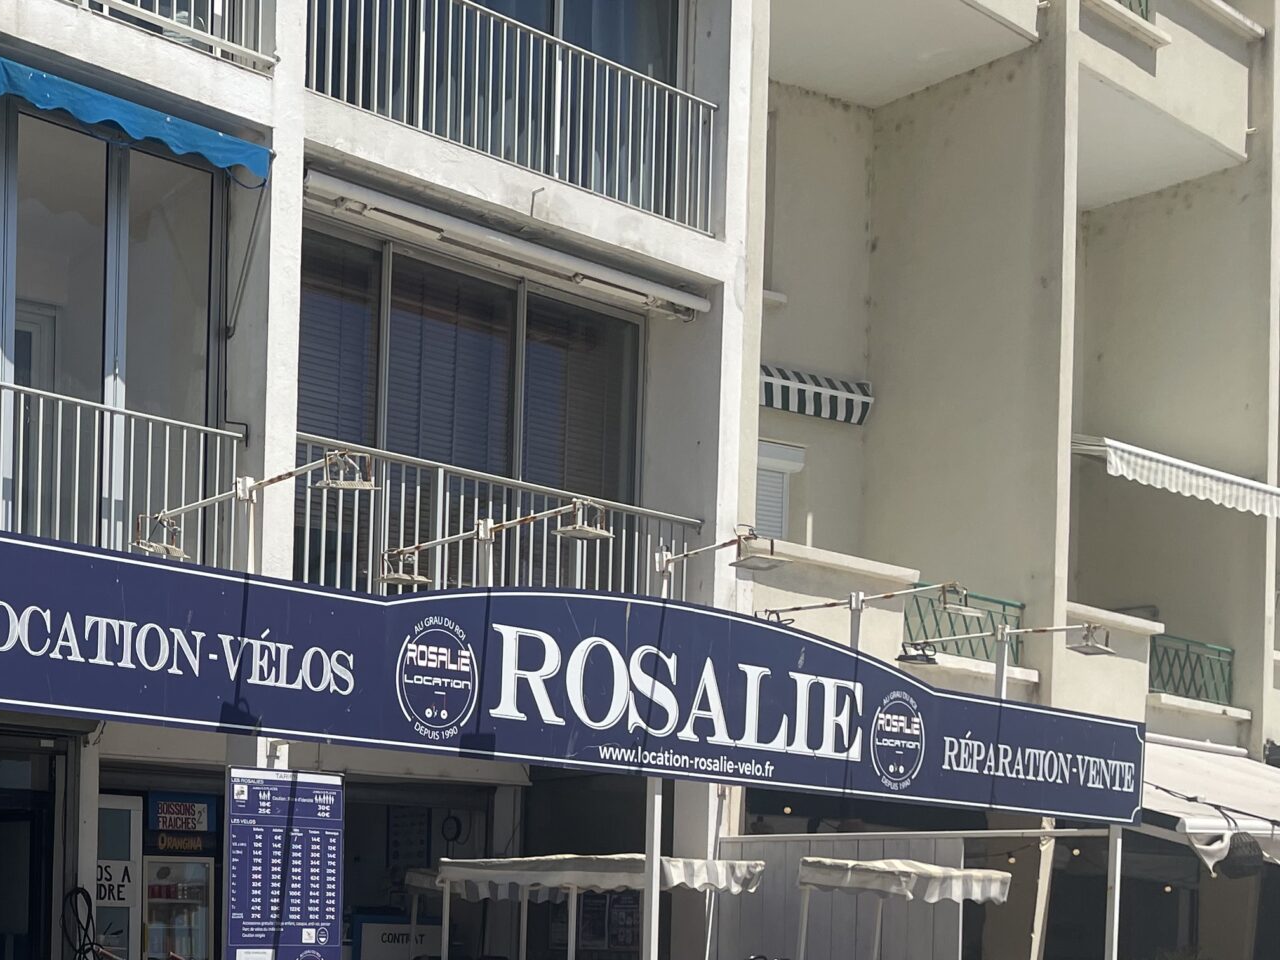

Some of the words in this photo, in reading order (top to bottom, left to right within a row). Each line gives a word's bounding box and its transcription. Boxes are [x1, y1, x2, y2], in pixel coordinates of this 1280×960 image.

[414, 622, 424, 634] AU
[424, 616, 443, 627] GRAU
[444, 618, 455, 630] DU
[454, 625, 467, 641] ROI
[489, 623, 864, 762] ROSALIE
[414, 722, 440, 740] DEPUIS
[441, 727, 458, 740] 1990
[599, 745, 774, 777] www.location-rosalie-velo.fr
[942, 730, 1135, 793] RÉPARATION-VENTE
[158, 802, 196, 816] BOISSONS
[158, 816, 197, 830] FRAICHES
